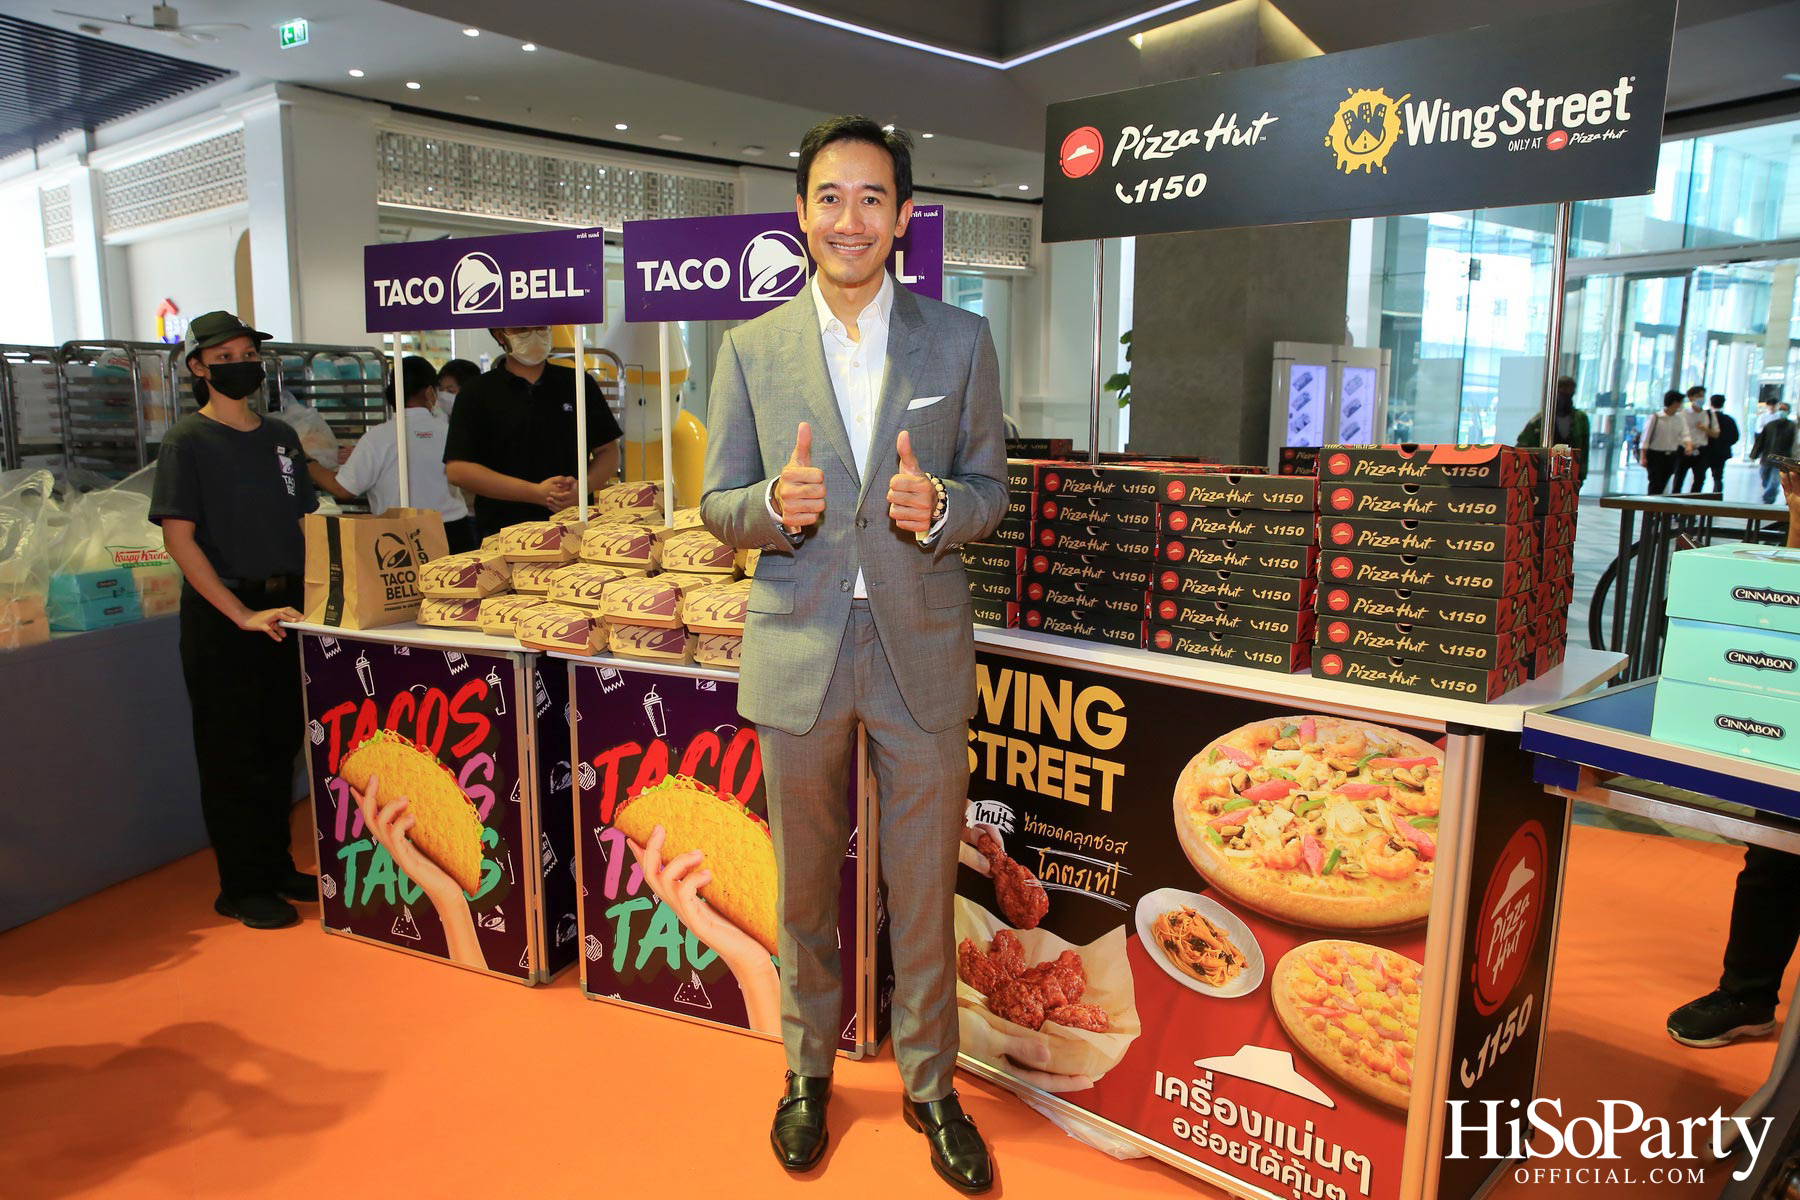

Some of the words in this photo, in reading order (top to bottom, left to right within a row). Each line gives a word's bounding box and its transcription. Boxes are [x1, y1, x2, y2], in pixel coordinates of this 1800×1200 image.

[1405, 76, 1634, 149] WingStreet
[1112, 124, 1201, 167] Pizza
[1204, 112, 1279, 151] Hut
[1508, 138, 1530, 152] ONLY
[1531, 137, 1543, 149] AT
[1569, 133, 1601, 146] Pizza
[1603, 129, 1628, 140] Hut
[1134, 173, 1208, 204] 1150
[637, 257, 731, 292] TACO
[374, 276, 445, 307] TACO
[510, 268, 584, 300] BELL
[1354, 460, 1396, 477] Pizza
[1398, 462, 1432, 477] Hut
[1451, 466, 1489, 478] 1150
[1008, 476, 1028, 485] 150
[1062, 479, 1091, 493] Pizza
[1092, 480, 1116, 493] Hut
[1129, 484, 1156, 494] 1150
[1189, 486, 1224, 502] Pizza
[1226, 489, 1255, 504] Hut
[1271, 494, 1304, 504] 1150
[1358, 495, 1401, 512] Pizza
[1402, 497, 1438, 514] Hut
[1457, 503, 1497, 515] 1150
[1008, 504, 1026, 512] 150
[1060, 507, 1088, 521] Pizza
[1088, 509, 1111, 523] Hut
[1123, 514, 1149, 525] 1150
[1002, 530, 1025, 540] 1150
[1191, 517, 1226, 533] Pizza
[1228, 521, 1256, 535] Hut
[1273, 525, 1304, 536] 1150
[1058, 535, 1087, 550] Pizza
[1087, 539, 1110, 551] Hut
[1123, 544, 1149, 554] 1150
[1357, 531, 1400, 548] Pizza
[1402, 534, 1436, 550] Hut
[1456, 539, 1495, 552] 1150
[988, 558, 1010, 567] 1150
[1188, 548, 1222, 564] Pizza
[1224, 552, 1251, 566] Hut
[1267, 558, 1299, 569] 1150
[380, 570, 417, 586] TACO
[1051, 562, 1081, 576] Pizza
[1081, 565, 1105, 579] Hut
[1118, 572, 1146, 583] 1150
[1357, 564, 1399, 582] Pizza
[1401, 568, 1435, 585] Hut
[1454, 575, 1493, 588] 1150
[386, 585, 418, 600] BELL
[989, 584, 1011, 595] 1150
[1182, 579, 1216, 594] Pizza
[1217, 583, 1245, 597] Hut
[1260, 590, 1291, 601] 1150
[1735, 588, 1800, 605] CINNABON
[1046, 590, 1074, 604] Pizza
[1075, 593, 1098, 608] Hut
[1111, 601, 1138, 612] 1150
[1353, 598, 1395, 615] Pizza
[1396, 603, 1429, 620] Hut
[1448, 611, 1487, 624] 1150
[981, 610, 1001, 620] 1150
[1180, 608, 1214, 624] Pizza
[1215, 613, 1243, 628] Hut
[1258, 621, 1289, 633] 1150
[1044, 617, 1072, 632] Pizza
[1073, 622, 1096, 636] Hut
[1108, 629, 1135, 641] 1150
[1176, 637, 1209, 654] Pizza
[1210, 643, 1237, 658] Hut
[1252, 652, 1282, 665] 1150
[1353, 630, 1395, 648] Pizza
[1396, 636, 1429, 653] Hut
[1449, 645, 1487, 658] 1150
[1728, 651, 1793, 670] CINNABON
[1346, 662, 1388, 680] Pizza
[1389, 670, 1421, 687] Hut
[1440, 679, 1478, 693] 1150
[1718, 717, 1781, 738] CINNABON
[593, 727, 763, 824] TACO
[975, 802, 1007, 827] ใหม่!
[1024, 812, 1128, 855] ไก่ทอดคลุกซอส
[1038, 847, 1119, 896] โคตรเท่!
[1486, 892, 1530, 967] Pizza
[1493, 919, 1526, 985] Hut
[1476, 994, 1533, 1081] 1150
[1155, 1070, 1372, 1196] เครื่องแน่นๆ
